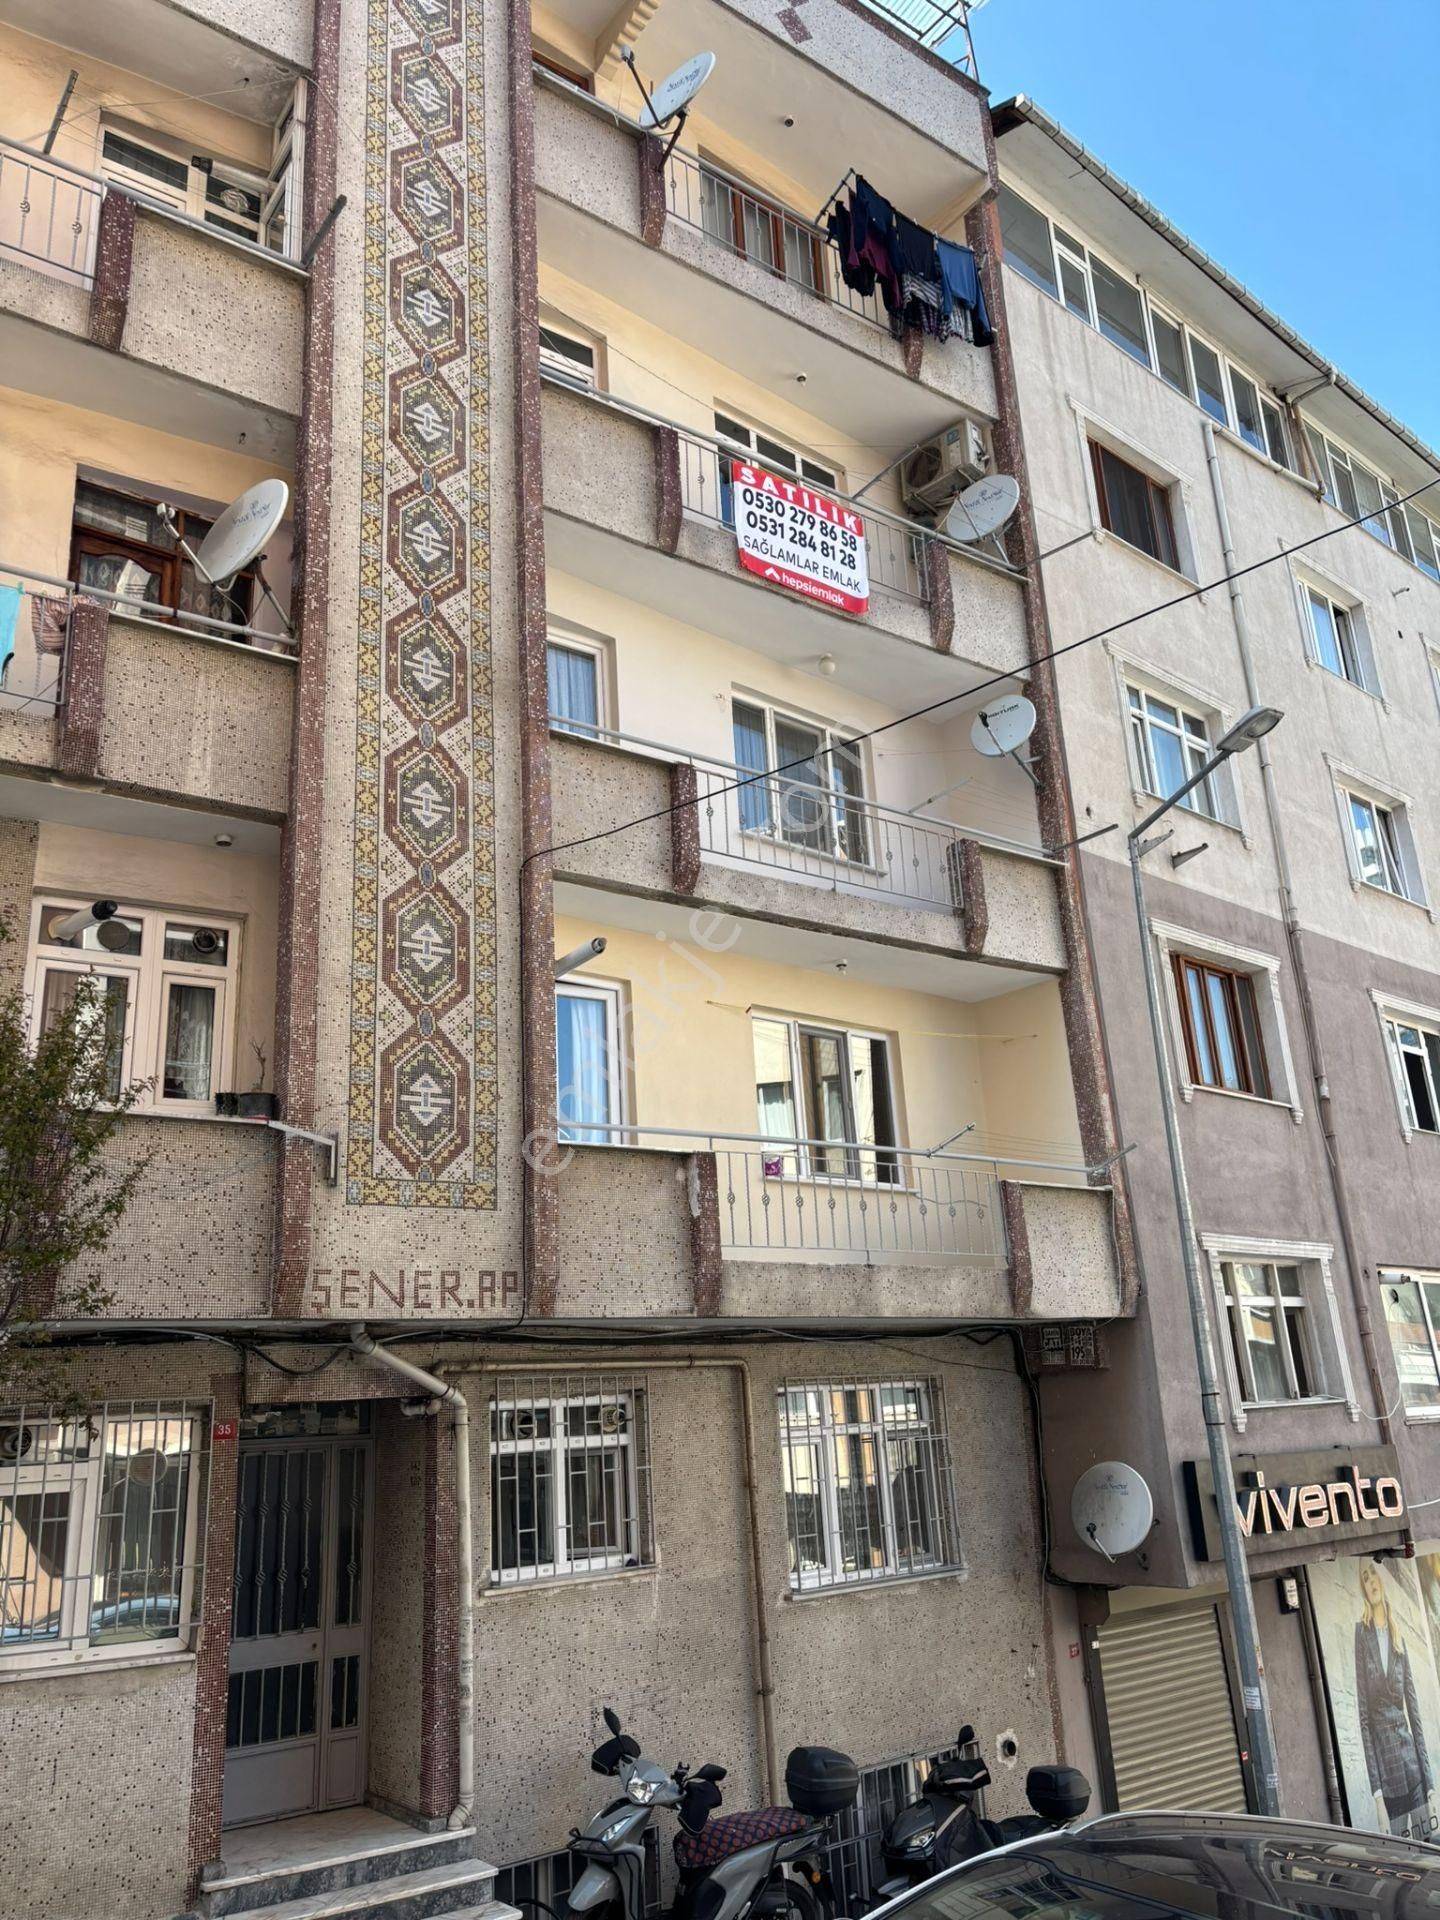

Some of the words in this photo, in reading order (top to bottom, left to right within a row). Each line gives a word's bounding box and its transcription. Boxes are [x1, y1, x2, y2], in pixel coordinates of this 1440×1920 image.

[741, 467, 857, 533] SATILIK
[743, 488, 785, 517] 0530
[790, 506, 816, 530] 279
[820, 520, 838, 541] 86
[841, 530, 857, 551] 58
[743, 535, 819, 575] SAĞLAMLAR
[823, 566, 861, 593] EMLAK
[746, 511, 784, 539] 0531
[789, 527, 817, 552] 284
[820, 542, 835, 561] 81
[839, 550, 856, 571] 28
[782, 572, 844, 606] hepsiemlak
[217, 1424, 231, 1435] 35
[1236, 1465, 1403, 1537] vivento
